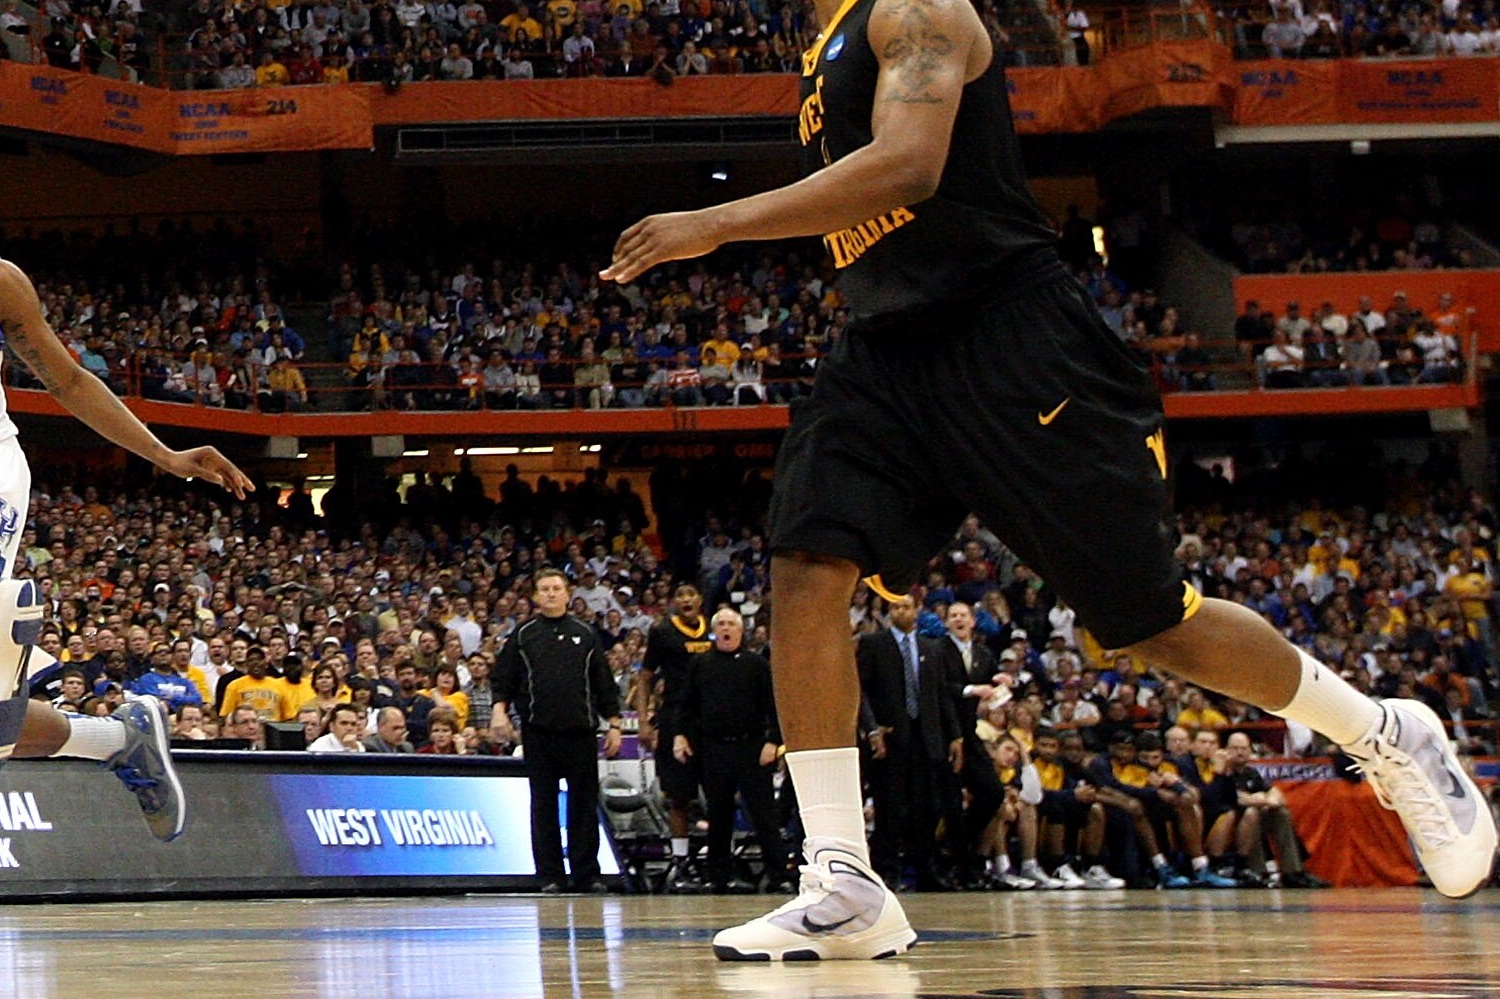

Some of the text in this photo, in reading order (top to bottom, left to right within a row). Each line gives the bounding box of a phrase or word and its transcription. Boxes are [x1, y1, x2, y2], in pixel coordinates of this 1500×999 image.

[180, 103, 231, 117] NCAA
[266, 100, 297, 115] 214
[307, 809, 494, 847] WEST VIRGINIA
